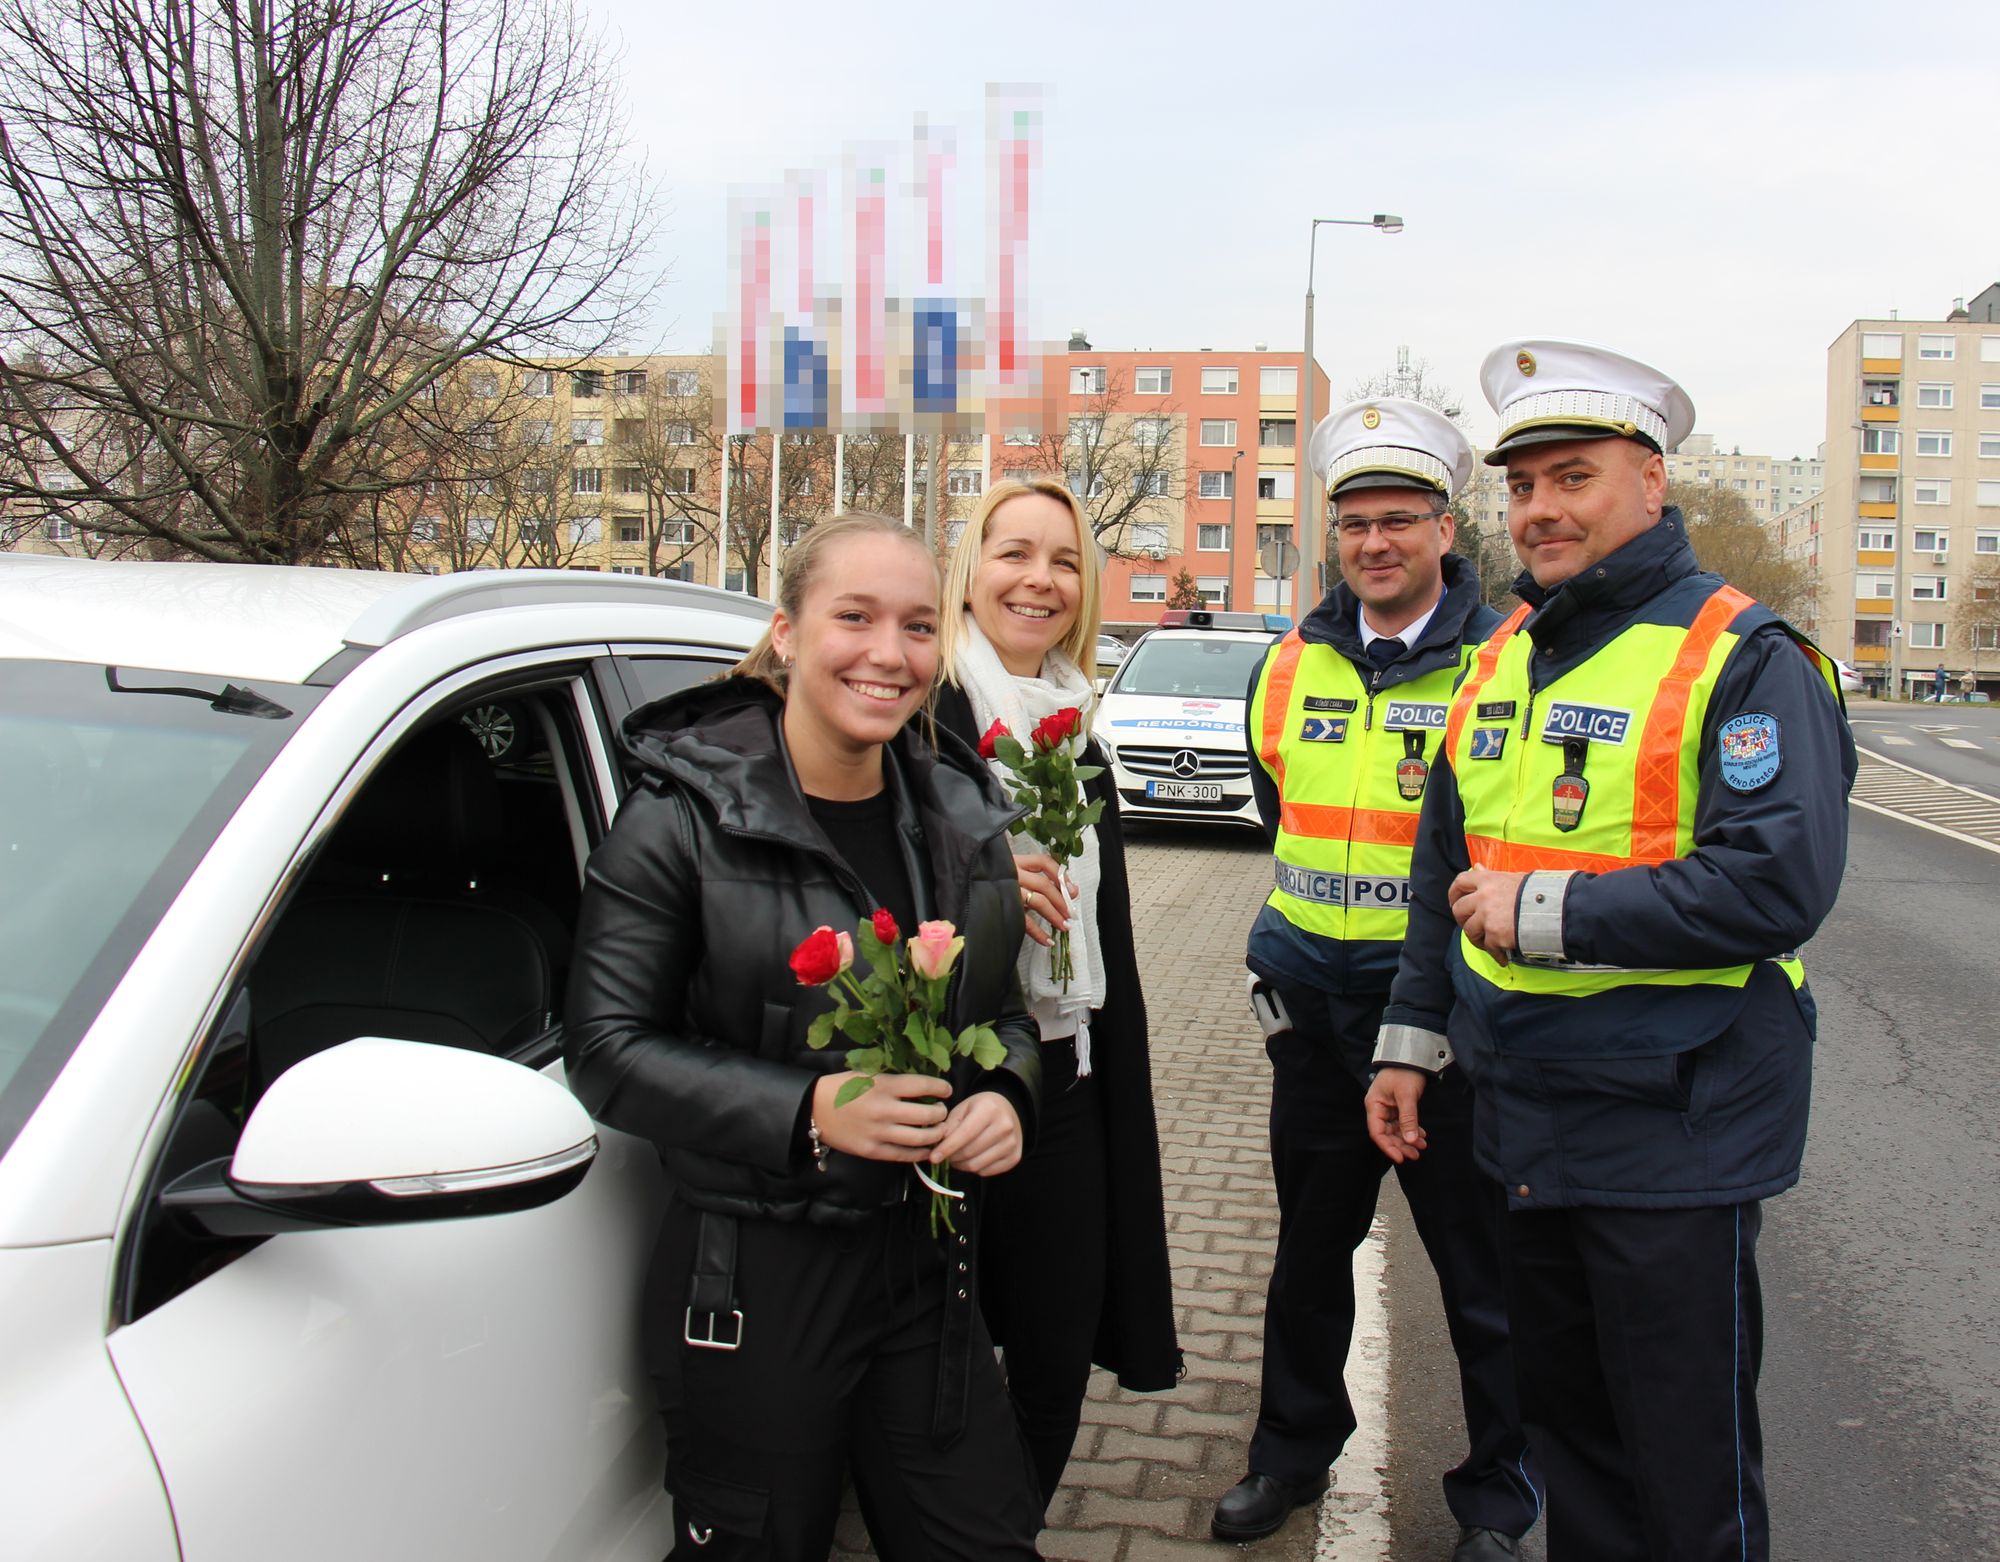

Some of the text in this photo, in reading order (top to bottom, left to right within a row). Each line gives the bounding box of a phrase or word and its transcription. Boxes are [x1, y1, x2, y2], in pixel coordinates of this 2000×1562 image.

[1388, 706, 1446, 725] POLIC
[1546, 708, 1626, 739] POLICE
[1727, 715, 1767, 732] POLICE
[1156, 784, 1218, 799] PNK-300
